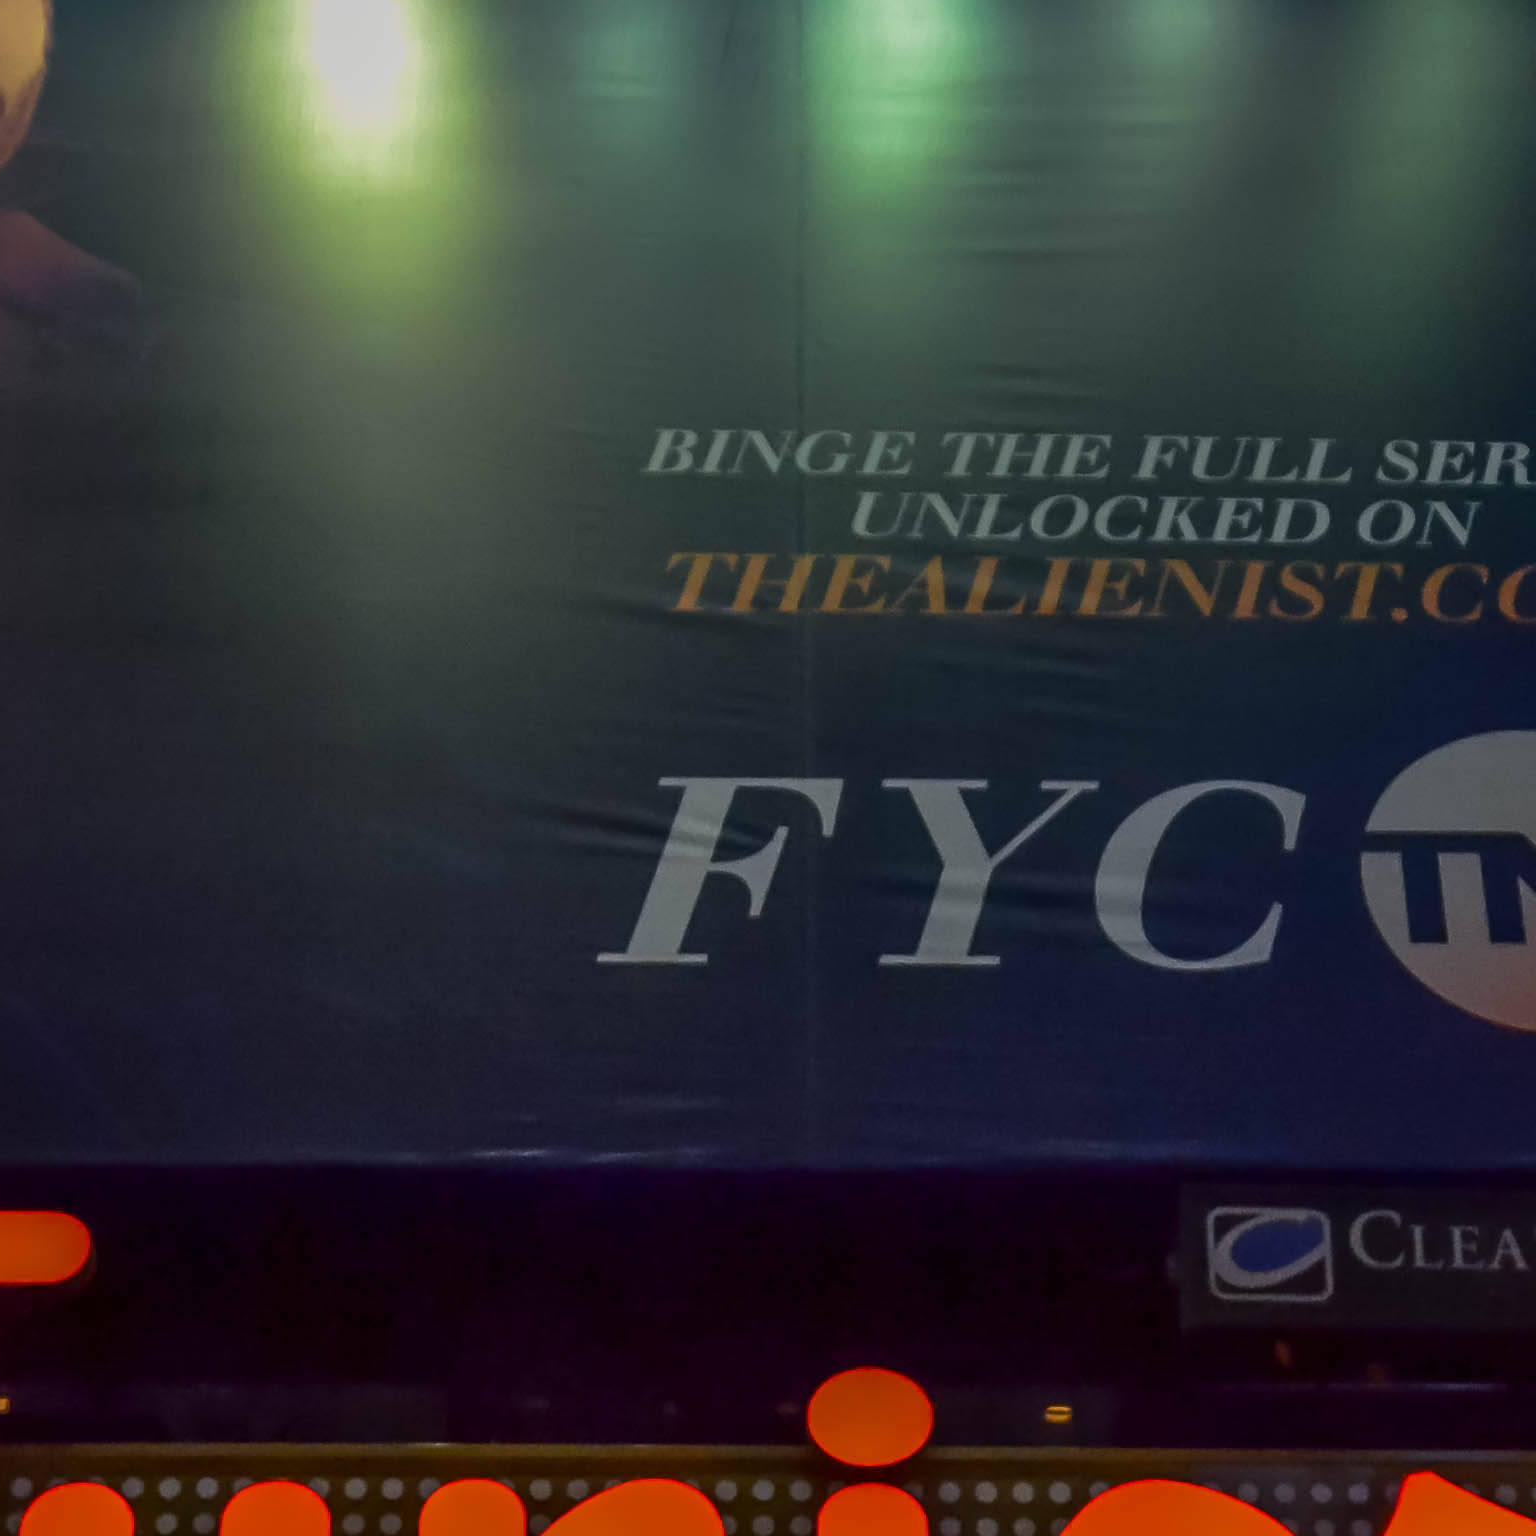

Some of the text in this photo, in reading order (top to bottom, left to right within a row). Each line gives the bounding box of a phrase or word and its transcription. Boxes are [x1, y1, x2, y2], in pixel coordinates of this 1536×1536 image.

[641, 428, 915, 477] BINGE
[940, 431, 1112, 479] THE
[1134, 434, 1356, 485] FULL
[850, 490, 1481, 549] UNLOCKED ON
[595, 775, 1308, 971] FYC
